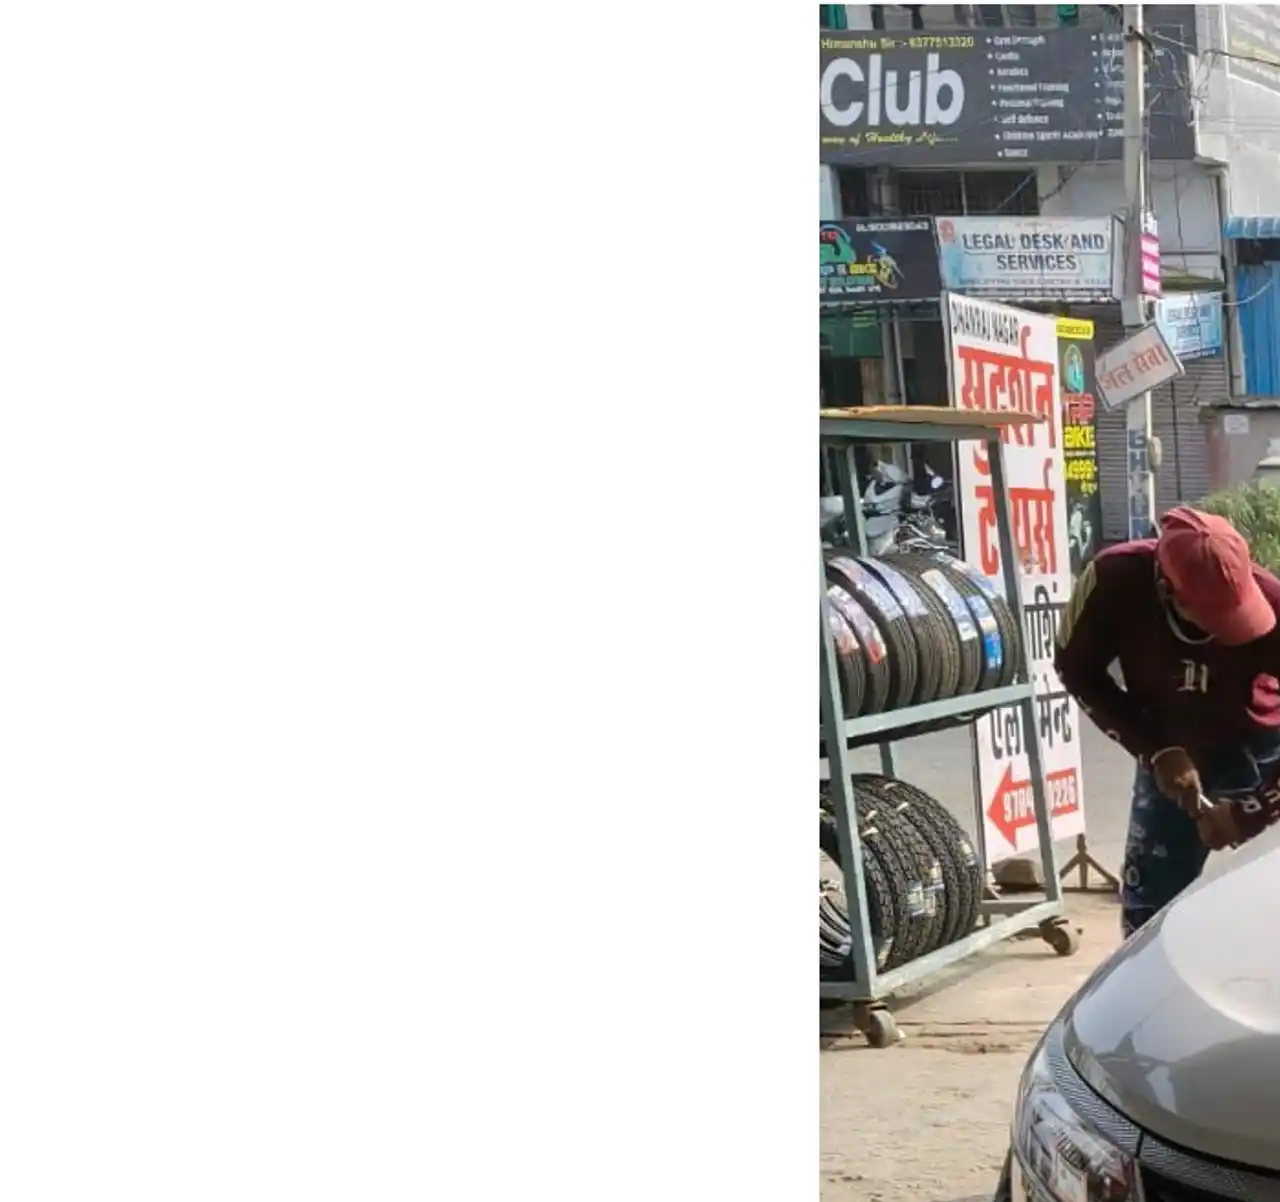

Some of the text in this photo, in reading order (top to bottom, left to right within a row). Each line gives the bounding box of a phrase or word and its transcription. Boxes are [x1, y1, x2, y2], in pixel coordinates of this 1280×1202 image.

[820, 52, 965, 127] Club
[963, 234, 1105, 250] LEGAL DESK AND
[996, 254, 1077, 271] SERVICES
